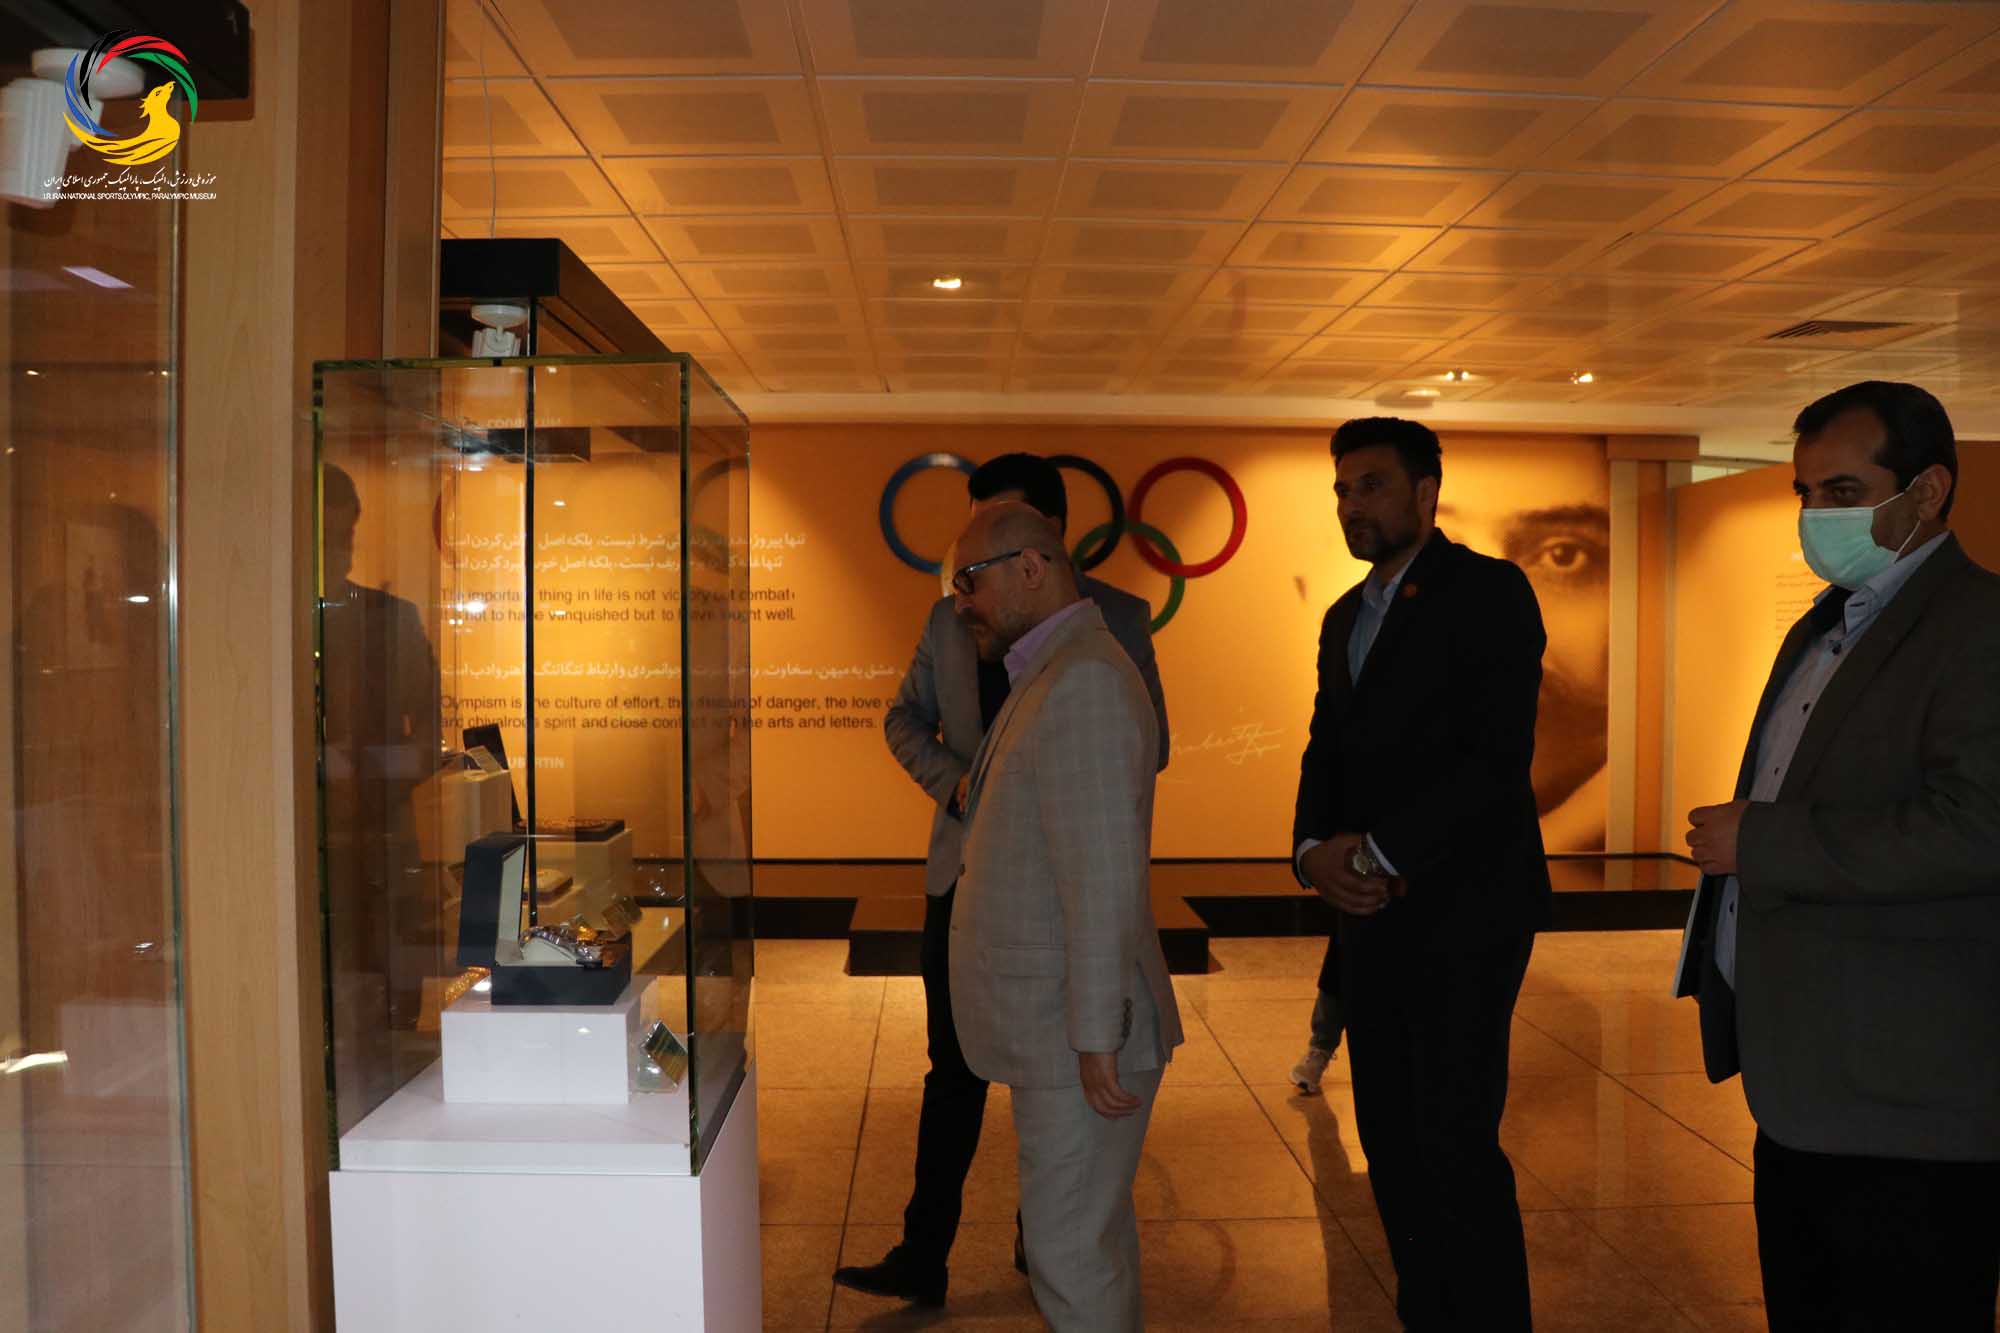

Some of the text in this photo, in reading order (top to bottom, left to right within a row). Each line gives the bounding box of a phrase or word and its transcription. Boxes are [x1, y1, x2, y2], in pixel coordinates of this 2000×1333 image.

[539, 588, 572, 605] thing
[577, 588, 590, 601] in
[594, 588, 613, 601] life
[617, 588, 630, 601] is
[634, 589, 656, 601] not
[491, 608, 505, 621] to
[507, 608, 545, 621] hae
[633, 608, 656, 621] but
[661, 608, 674, 621] to
[765, 608, 798, 621] well.
[511, 695, 522, 709] is
[554, 695, 601, 709] culture
[605, 695, 619, 709] of
[750, 695, 762, 709] of
[765, 695, 822, 713] danger,
[825, 695, 848, 709] the
[851, 695, 881, 709] love
[544, 714, 577, 732] spirit
[581, 714, 608, 729] and
[610, 714, 643, 729] close
[766, 714, 795, 729] arts
[797, 714, 826, 729] and
[829, 714, 877, 729] letters.
